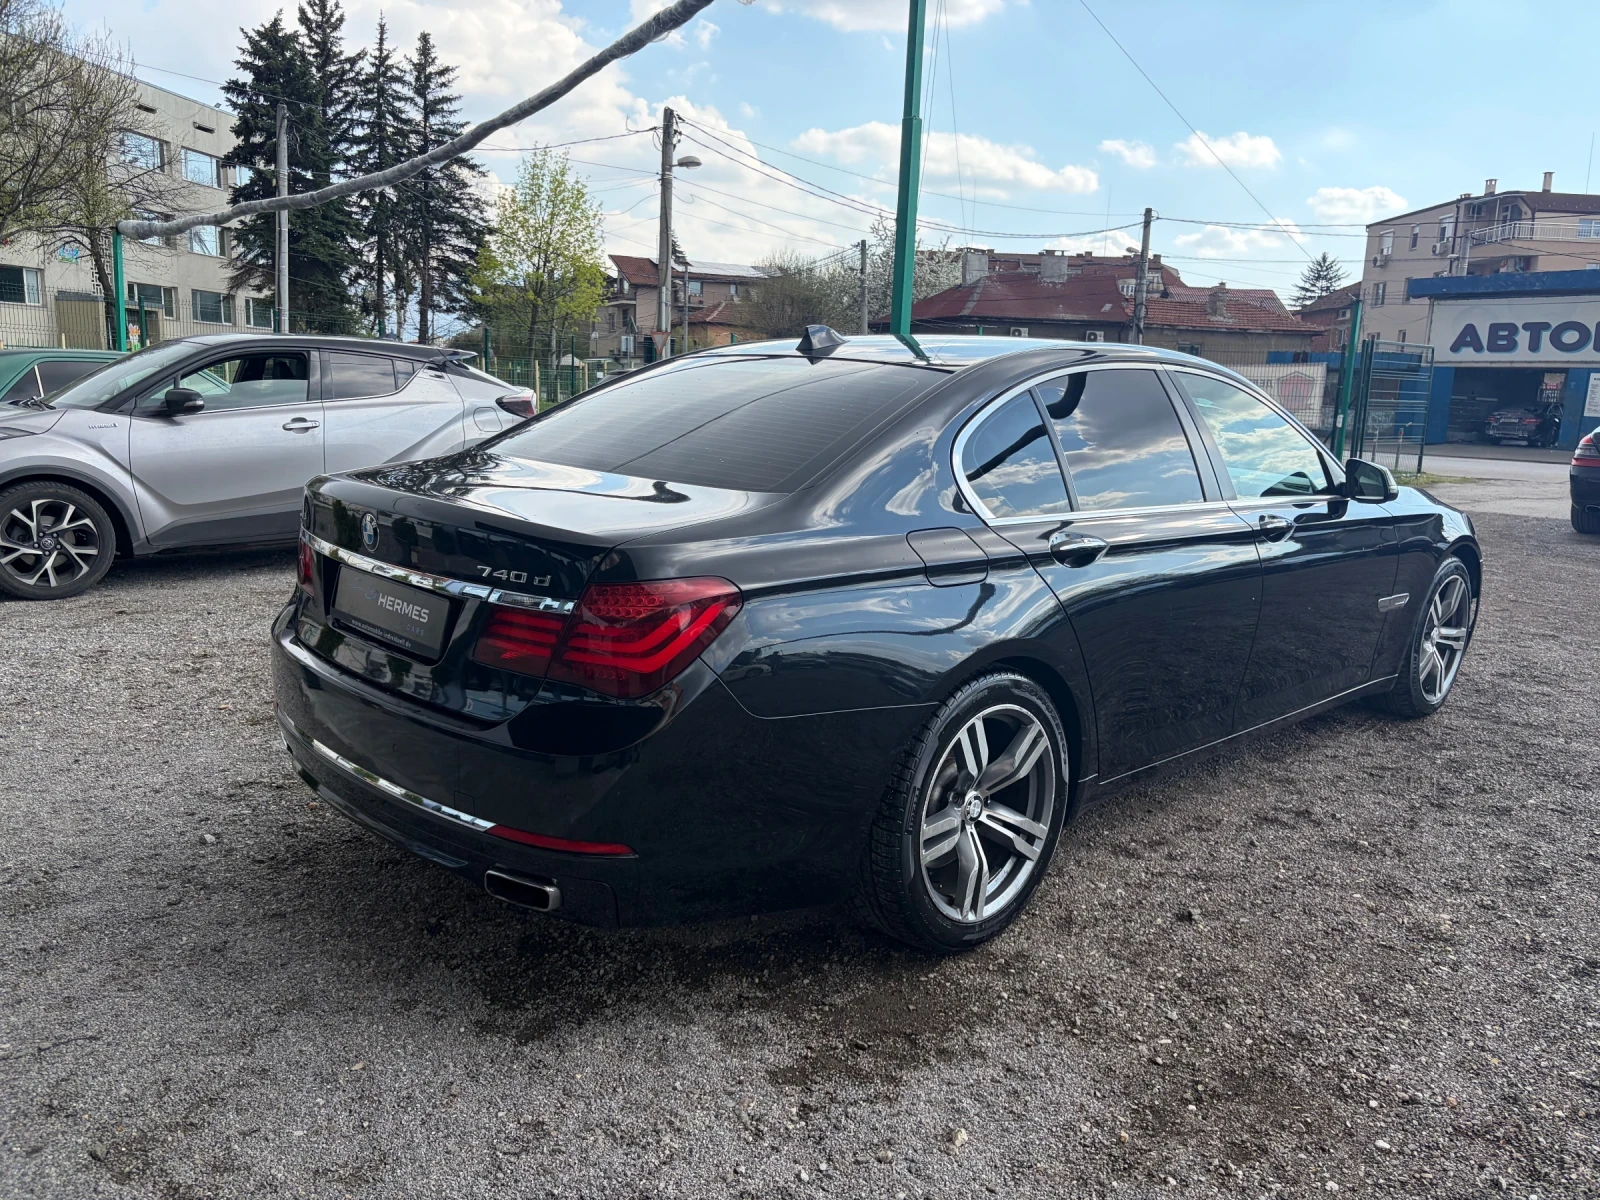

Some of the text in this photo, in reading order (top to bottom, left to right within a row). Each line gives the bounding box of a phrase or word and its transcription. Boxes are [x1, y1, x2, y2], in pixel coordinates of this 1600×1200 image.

[1449, 320, 1600, 353] АВТО
[477, 565, 552, 587] 740 d
[377, 592, 430, 623] HERMES
[406, 624, 425, 637] CARS
